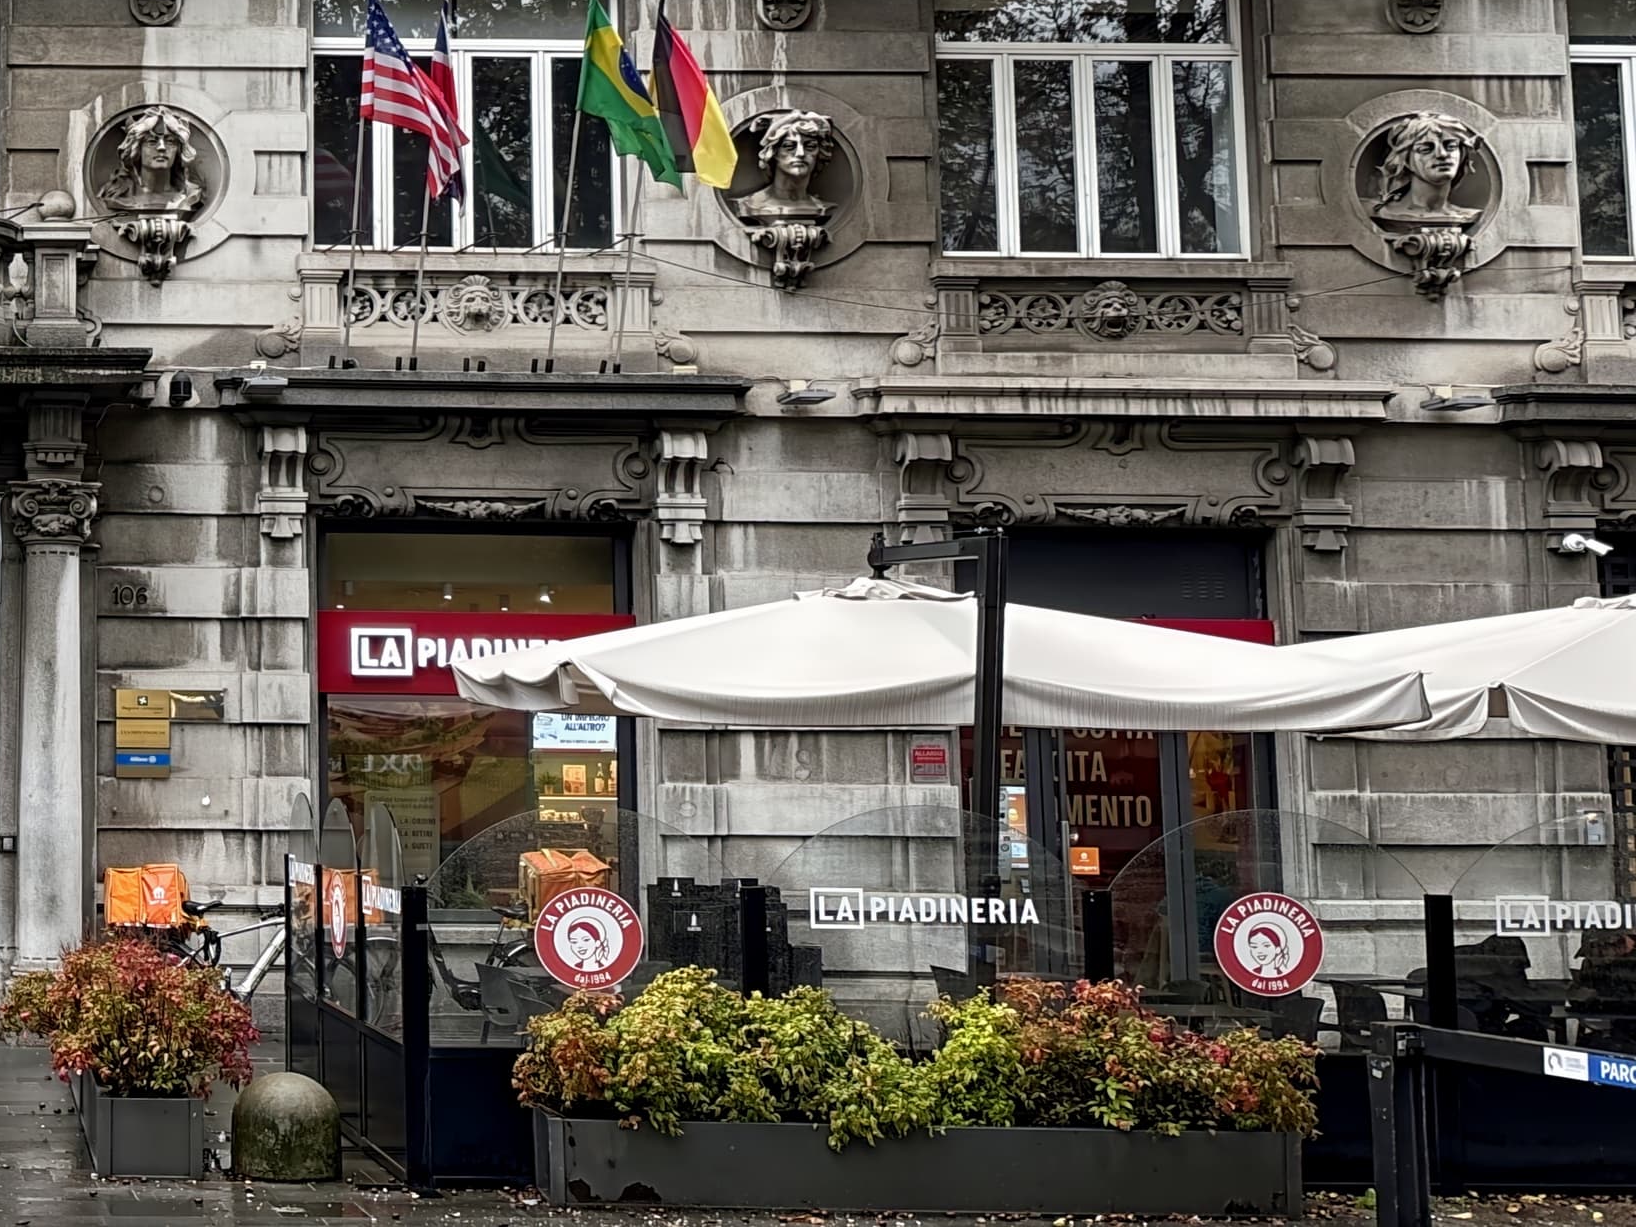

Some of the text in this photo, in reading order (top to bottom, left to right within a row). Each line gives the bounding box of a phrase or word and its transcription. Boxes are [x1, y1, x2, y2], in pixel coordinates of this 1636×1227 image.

[112, 586, 148, 605] 106
[360, 637, 403, 668] LA
[540, 893, 634, 932] LA PIADINERIA
[818, 895, 1040, 924] LA PIADINERIA
[1220, 898, 1316, 938] LA PIADINERIA
[1504, 902, 1541, 928] LA
[574, 971, 612, 984] dal 1994
[1252, 978, 1290, 991] dal 1994
